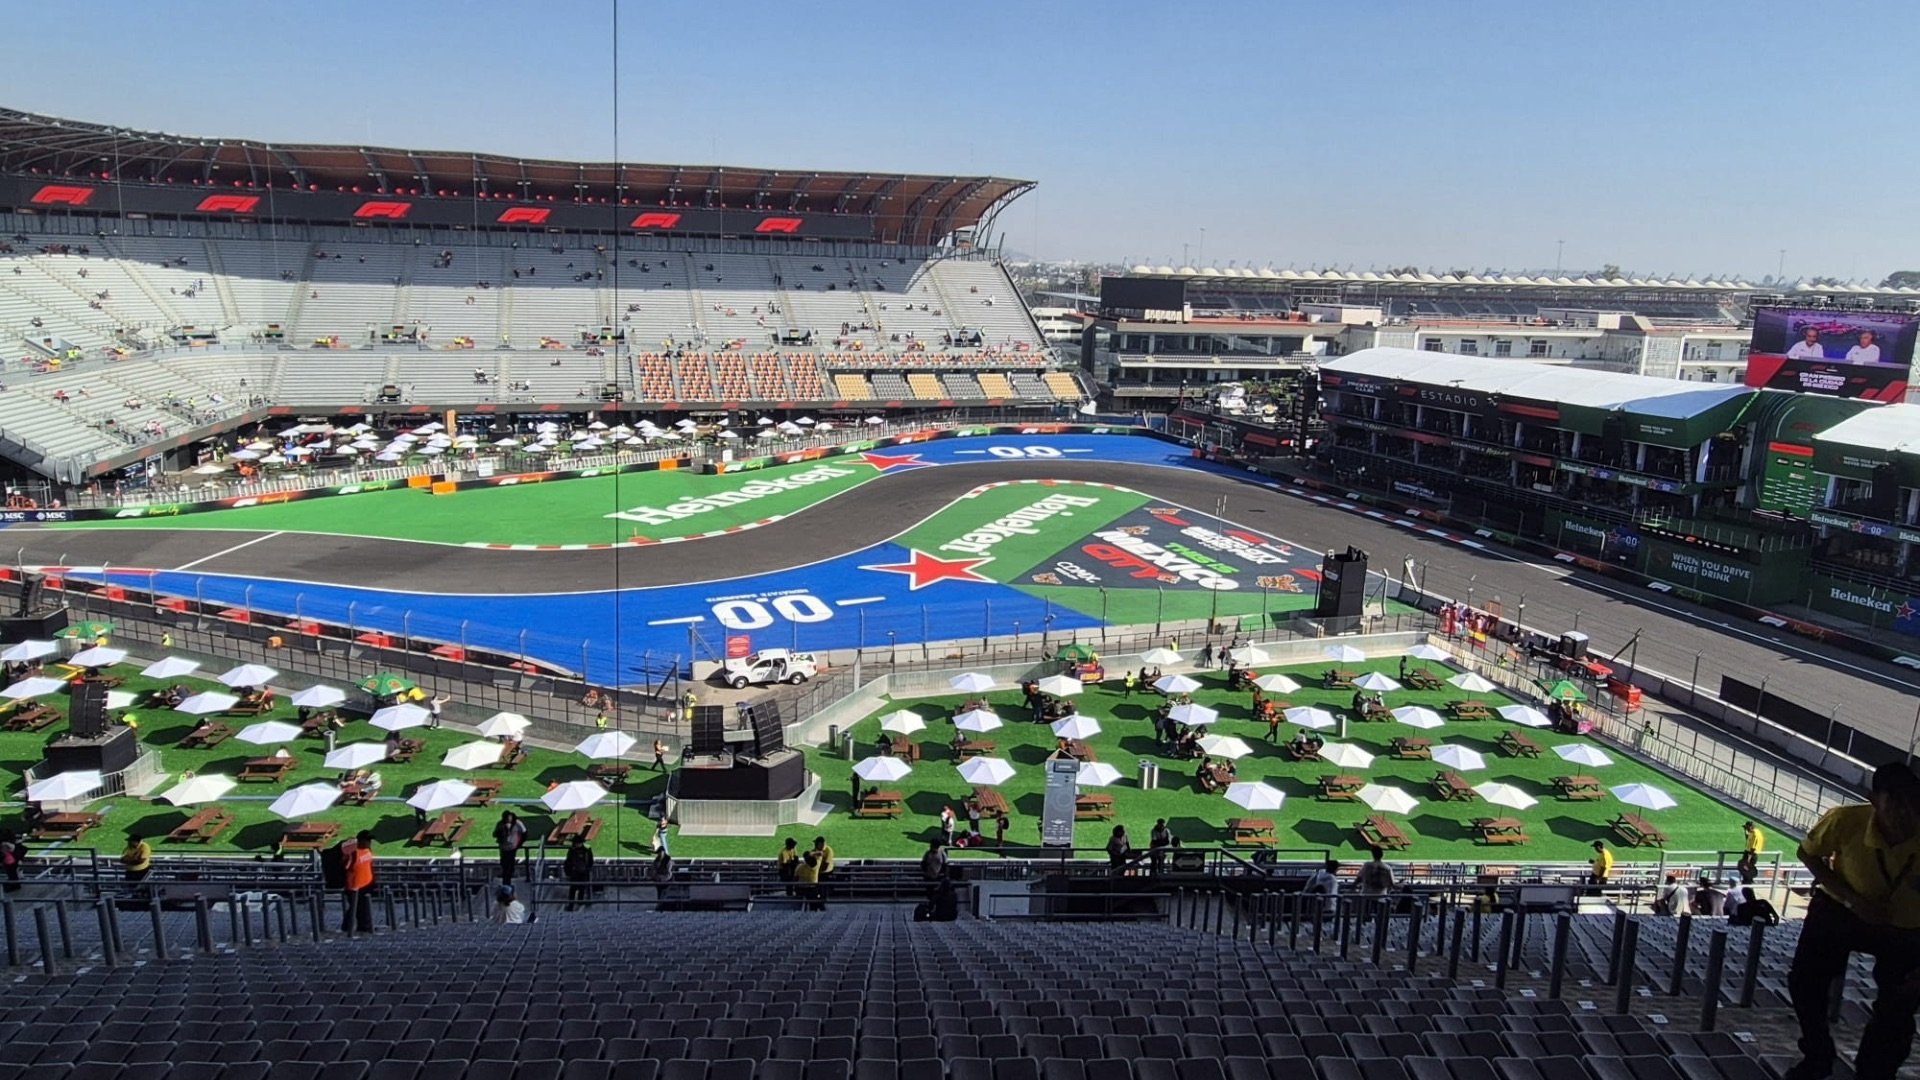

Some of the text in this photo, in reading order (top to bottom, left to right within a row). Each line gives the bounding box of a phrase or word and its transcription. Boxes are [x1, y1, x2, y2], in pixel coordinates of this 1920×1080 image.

[1420, 390, 1477, 407] ESTADIO
[603, 464, 856, 526] Heineken
[939, 493, 1100, 554] Heineken
[1811, 513, 1849, 528] Heineken
[1056, 561, 1102, 584] CDMX
[1081, 543, 1160, 579] CITY
[1093, 530, 1240, 590] MEXICO
[1672, 552, 1752, 579] WHEN YOU DRIVE
[1701, 570, 1731, 583] DRINK
[1830, 588, 1891, 612] Heineken
